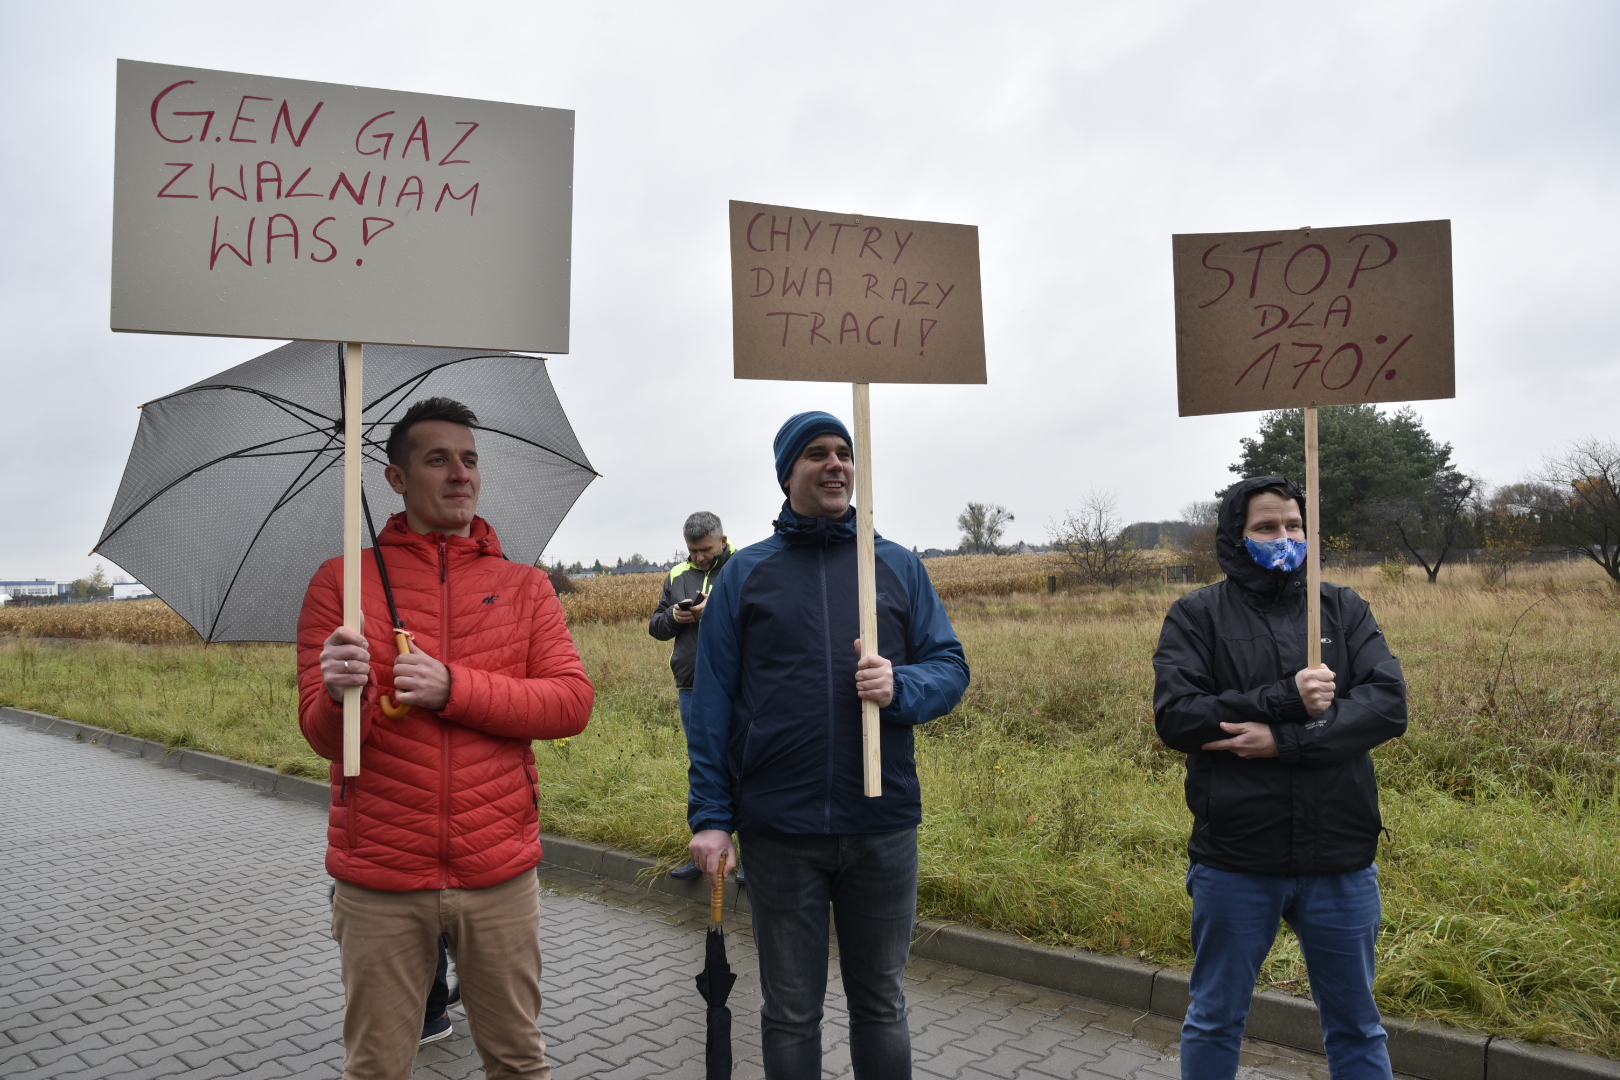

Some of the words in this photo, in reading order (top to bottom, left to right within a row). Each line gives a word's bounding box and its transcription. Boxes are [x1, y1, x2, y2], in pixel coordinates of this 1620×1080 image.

[150, 80, 324, 147] G.EN
[355, 110, 481, 167] GAZ
[156, 160, 481, 217] ZWALNIAM
[209, 212, 396, 270] WAS!
[746, 211, 914, 265] CHYTRY
[750, 266, 833, 298] DWA
[861, 273, 955, 309] RAZY
[1198, 232, 1399, 309] STOP
[766, 311, 938, 356] TRACI!
[1252, 295, 1352, 340] DLA
[1234, 334, 1414, 395] 170%
